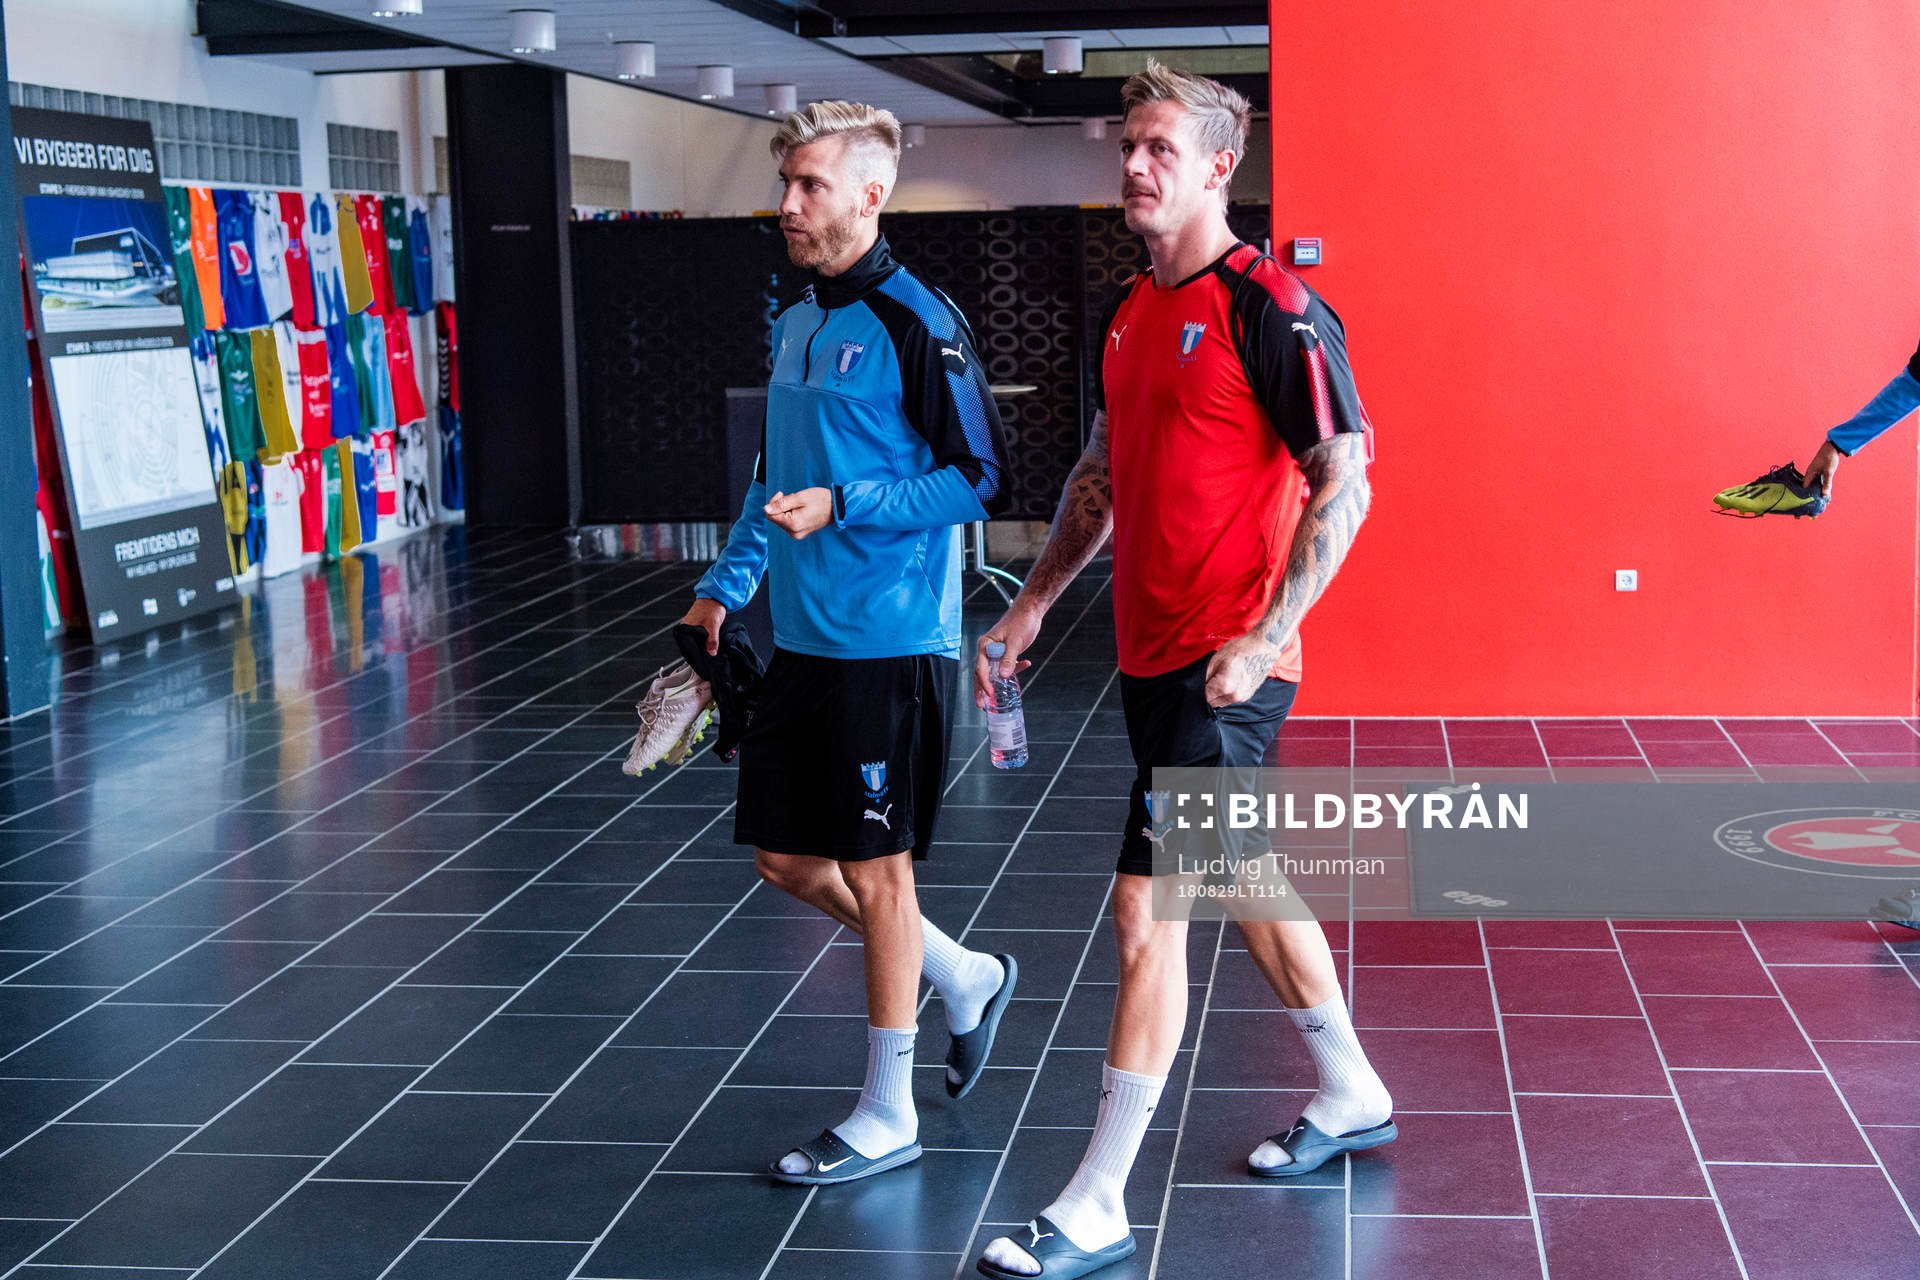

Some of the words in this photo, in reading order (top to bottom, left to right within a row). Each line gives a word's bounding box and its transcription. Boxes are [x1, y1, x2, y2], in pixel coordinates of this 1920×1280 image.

[13, 136, 34, 165] VI
[34, 138, 97, 169] BYGGER
[97, 144, 128, 171] FOR
[127, 147, 154, 173] DIG
[1442, 890, 1509, 908] ege
